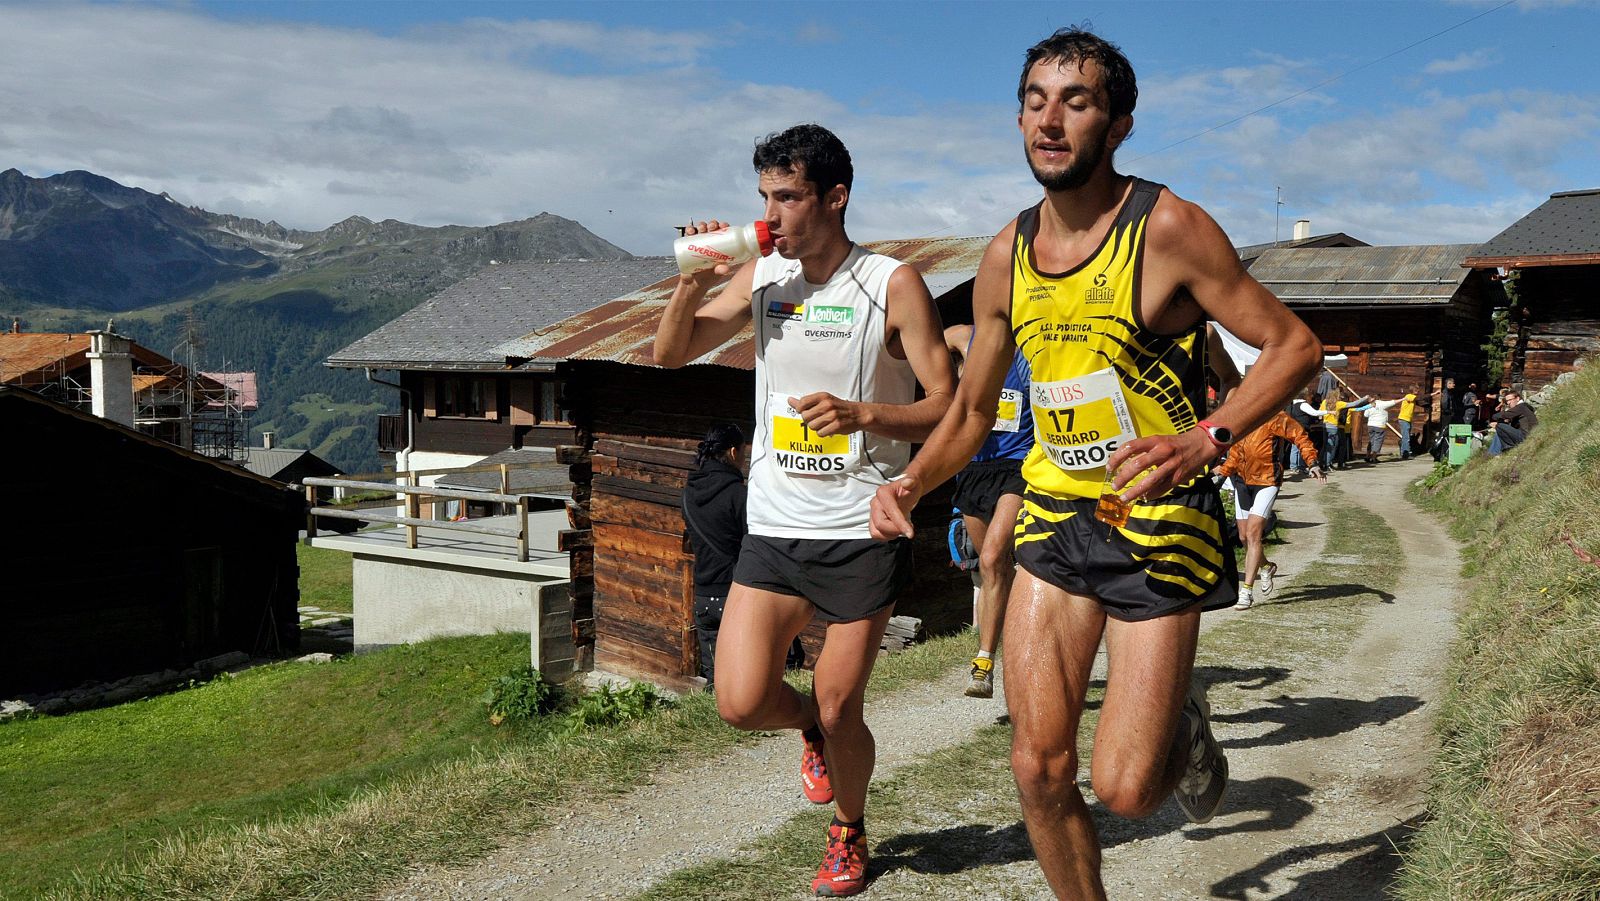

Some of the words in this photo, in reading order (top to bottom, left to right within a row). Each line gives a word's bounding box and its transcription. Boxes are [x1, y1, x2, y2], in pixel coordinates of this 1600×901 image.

[1085, 287, 1115, 301] elleffe
[1049, 384, 1084, 404] UBS
[1048, 408, 1075, 432] 17
[1046, 430, 1100, 445] BERNARD
[790, 441, 823, 453] KILIAN
[776, 453, 845, 471] MIGROS
